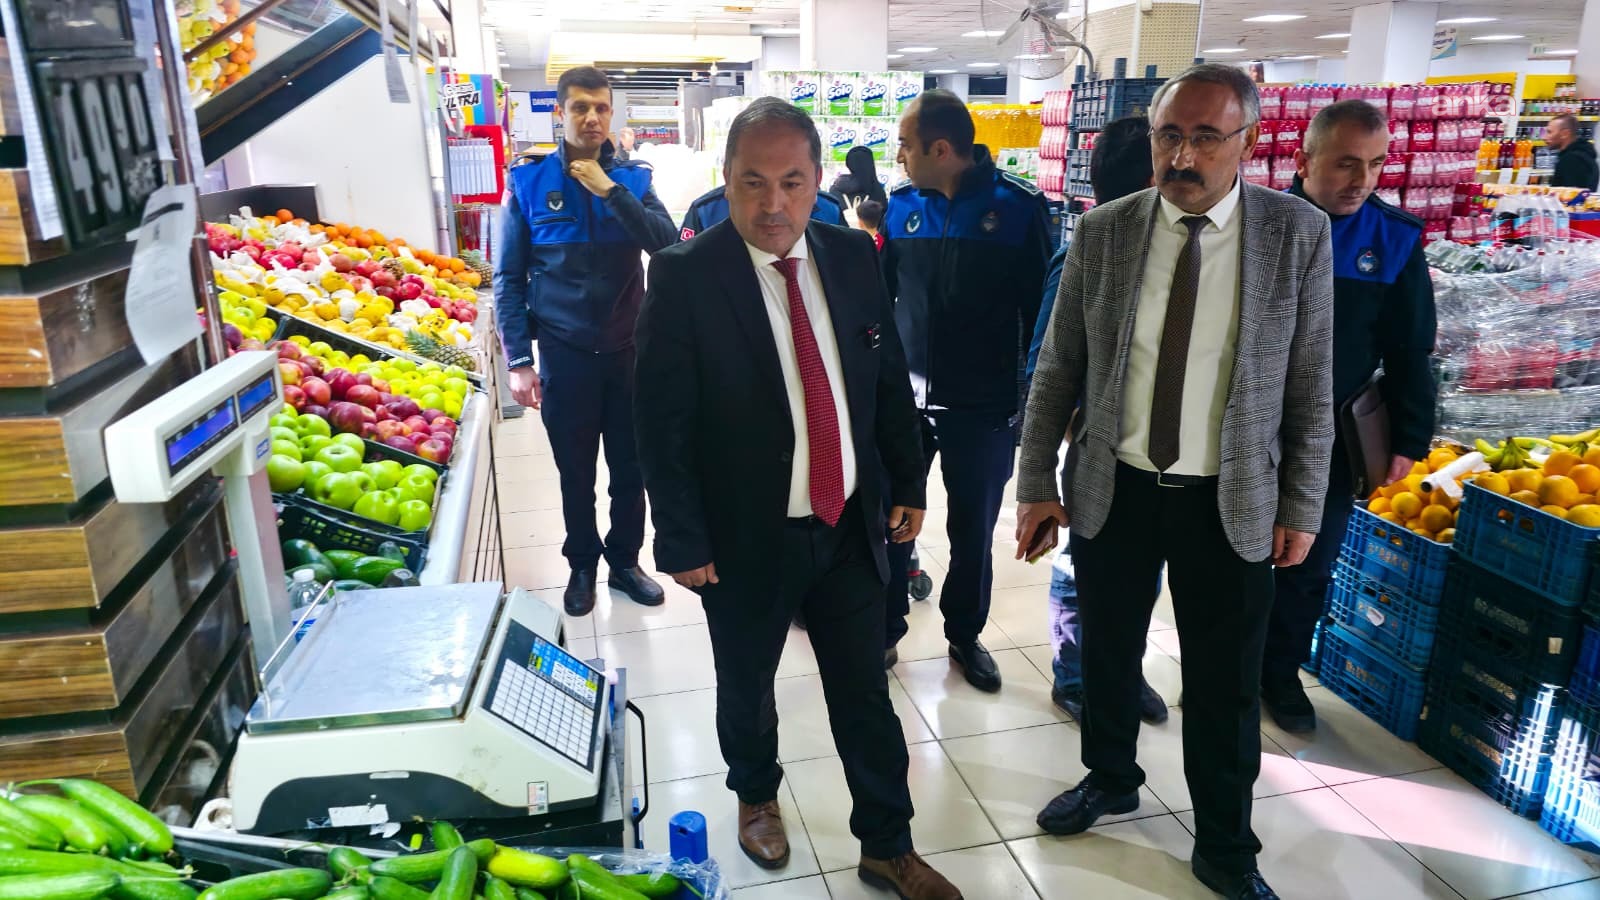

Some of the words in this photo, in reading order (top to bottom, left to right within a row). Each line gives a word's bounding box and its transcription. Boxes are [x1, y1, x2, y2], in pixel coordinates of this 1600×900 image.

[791, 83, 817, 99] Solo
[828, 84, 853, 99] Solo
[861, 84, 887, 99] Solo
[896, 84, 920, 99] Solo
[830, 129, 856, 145] Solo
[864, 129, 889, 145] Solo
